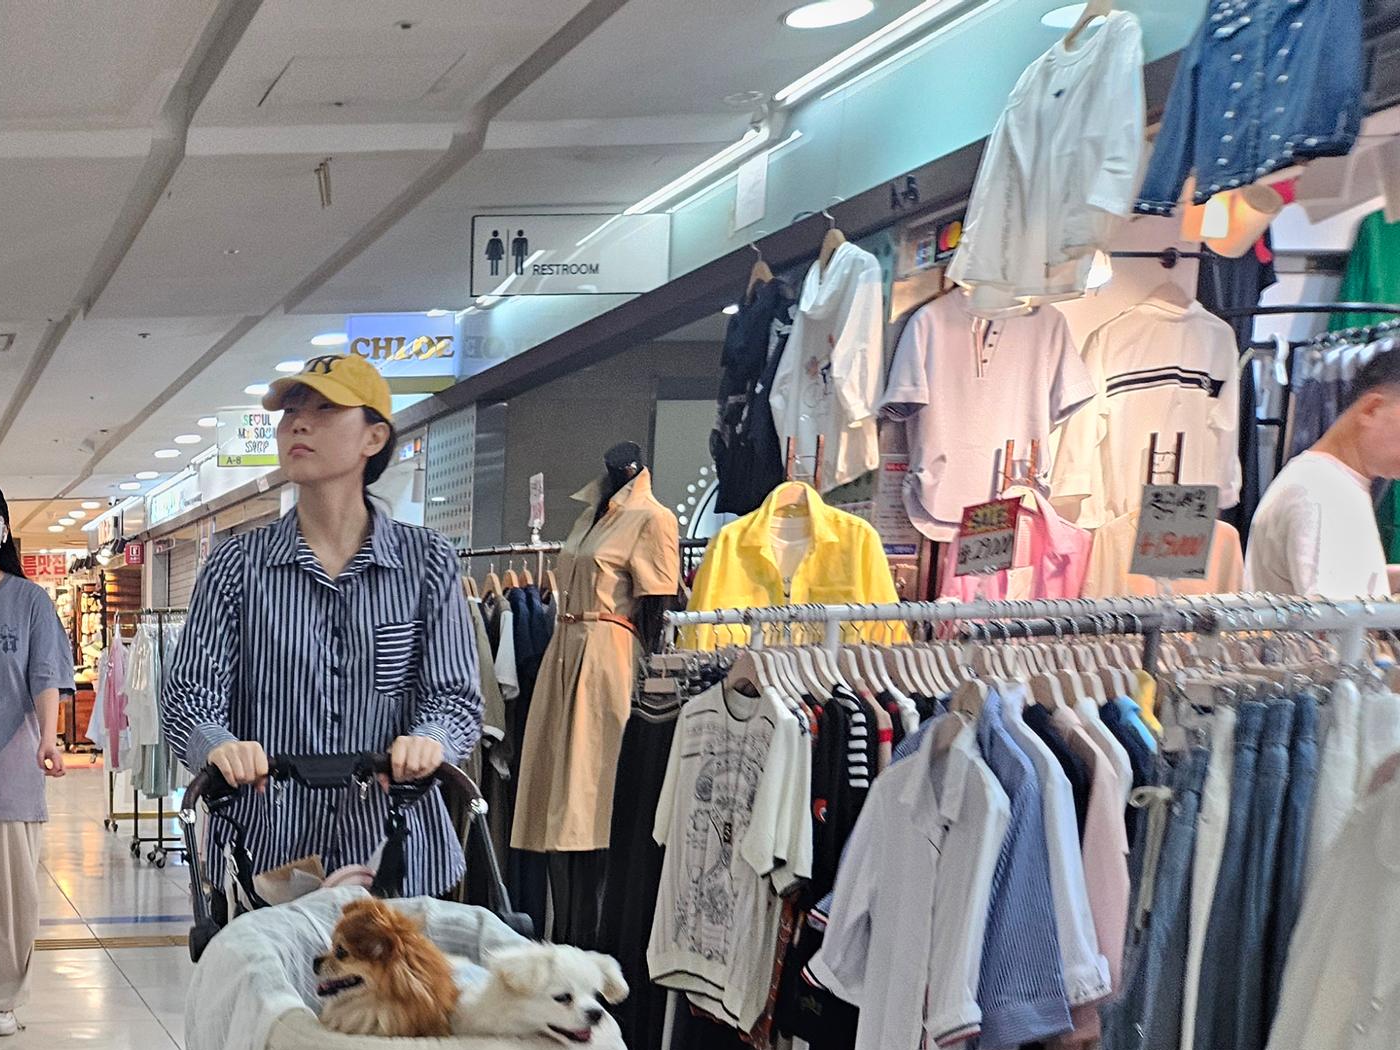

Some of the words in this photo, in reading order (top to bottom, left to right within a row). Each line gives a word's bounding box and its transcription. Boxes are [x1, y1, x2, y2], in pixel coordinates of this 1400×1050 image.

[532, 264, 599, 276] RESTROOM
[350, 335, 455, 361] CHLOE
[226, 457, 242, 465] A-8
